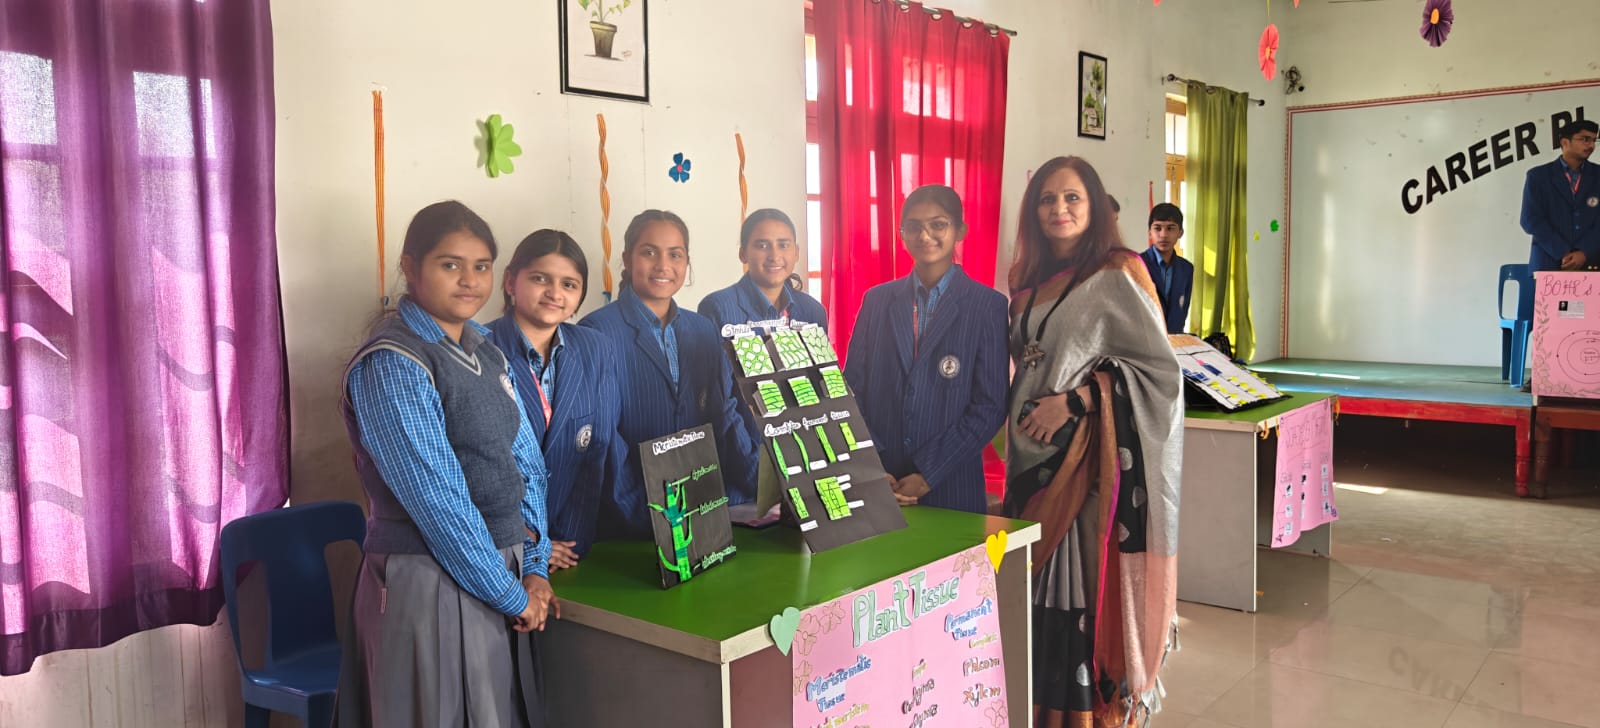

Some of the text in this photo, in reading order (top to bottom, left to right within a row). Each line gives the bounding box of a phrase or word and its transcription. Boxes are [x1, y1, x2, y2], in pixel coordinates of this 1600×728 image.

[1401, 121, 1540, 214] CAREER
[852, 570, 960, 648] Plant Tissue
